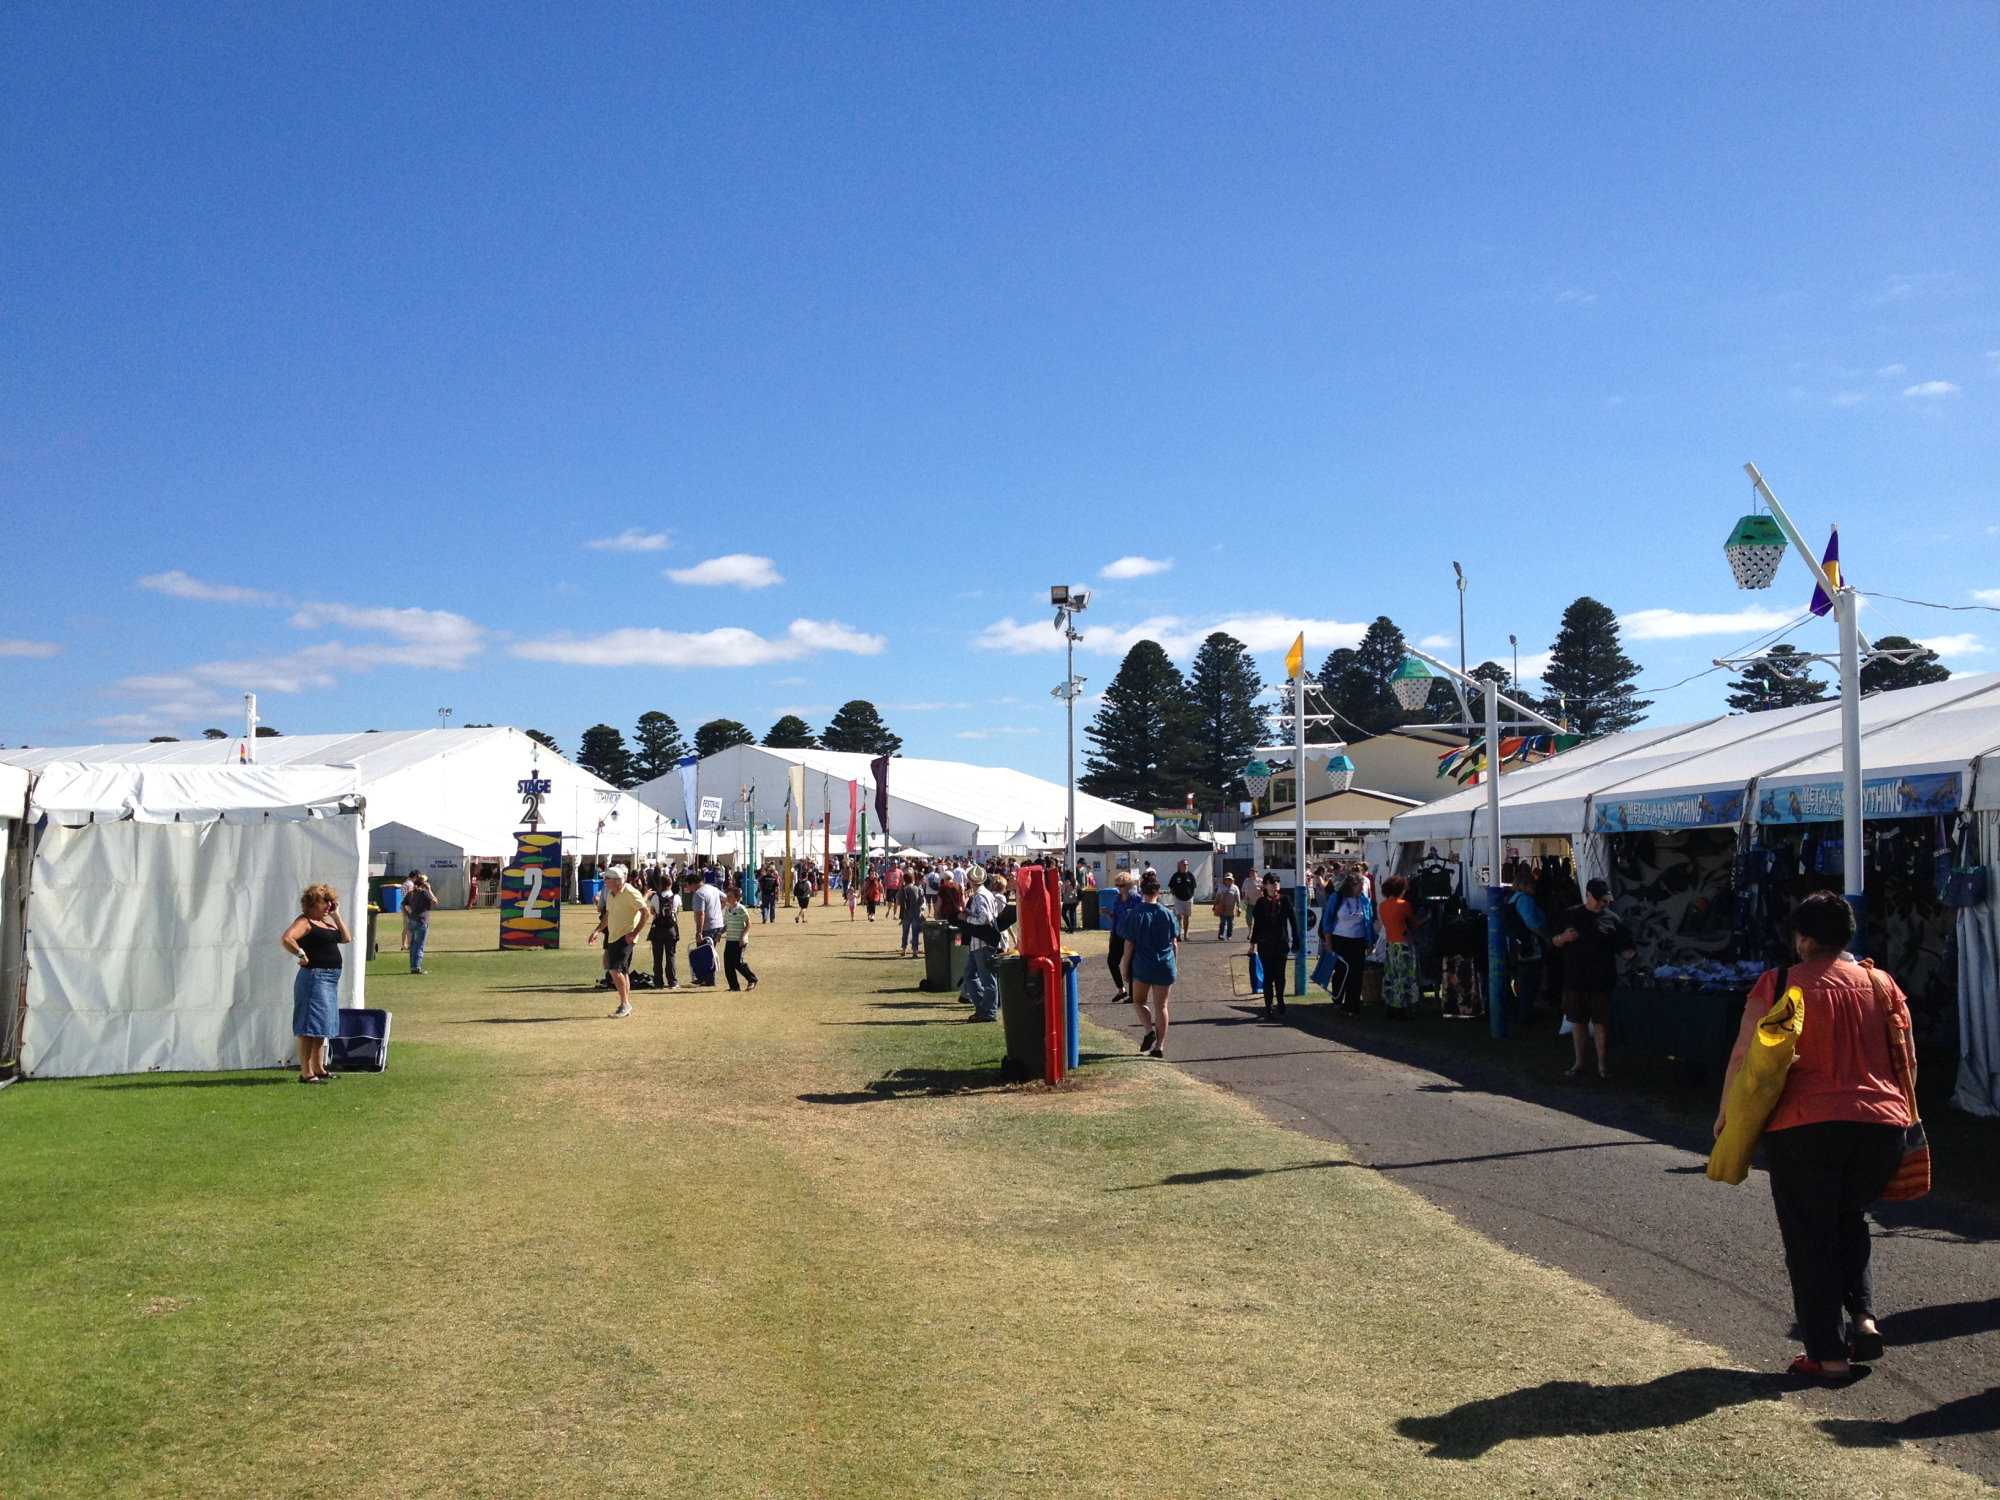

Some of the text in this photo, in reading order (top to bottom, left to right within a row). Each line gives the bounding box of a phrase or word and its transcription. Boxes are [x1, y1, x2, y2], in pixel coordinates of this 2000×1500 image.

[517, 779, 552, 794] STAGE
[702, 799, 720, 809] FESTIVAL
[1802, 786, 1832, 804] METAL
[1835, 788, 1844, 806] A
[519, 793, 539, 825] 2
[702, 809, 718, 819] OFFICE
[1627, 801, 1651, 817] METAL
[1662, 795, 1703, 823] ANYTHING
[1801, 802, 1823, 814] METAL
[1155, 817, 1198, 832] PIZZA
[1475, 867, 1490, 886] $5
[523, 867, 543, 918] 2
